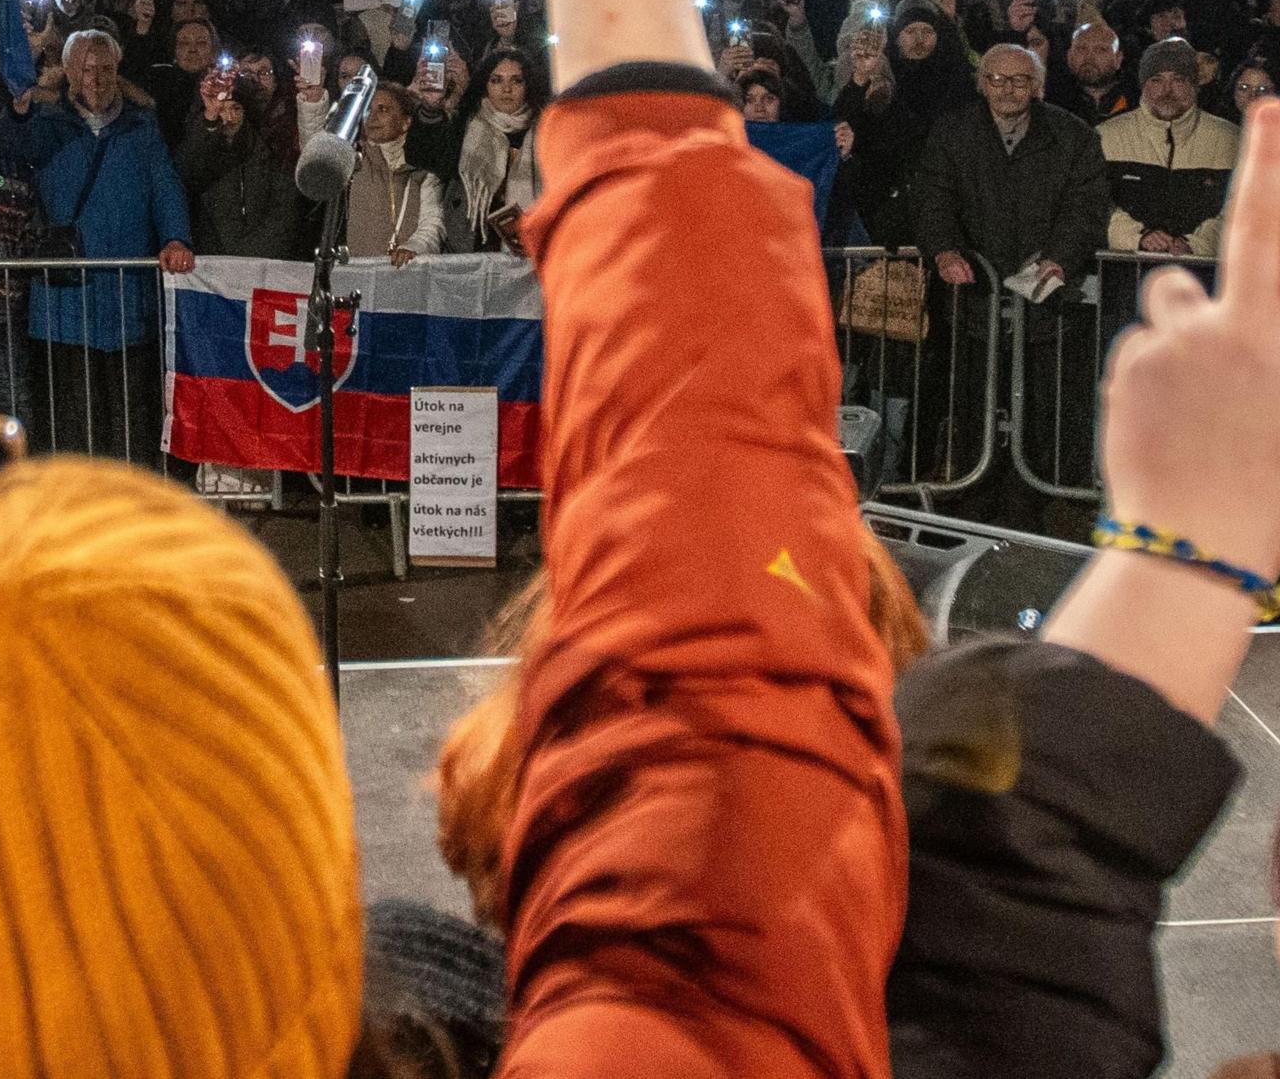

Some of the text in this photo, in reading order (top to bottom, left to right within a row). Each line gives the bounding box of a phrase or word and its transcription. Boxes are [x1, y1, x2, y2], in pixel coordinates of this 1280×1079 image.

[414, 398, 465, 413] Útok na
[414, 421, 462, 436] verejne
[413, 473, 483, 488] občanov je
[413, 504, 487, 517] útok na nás
